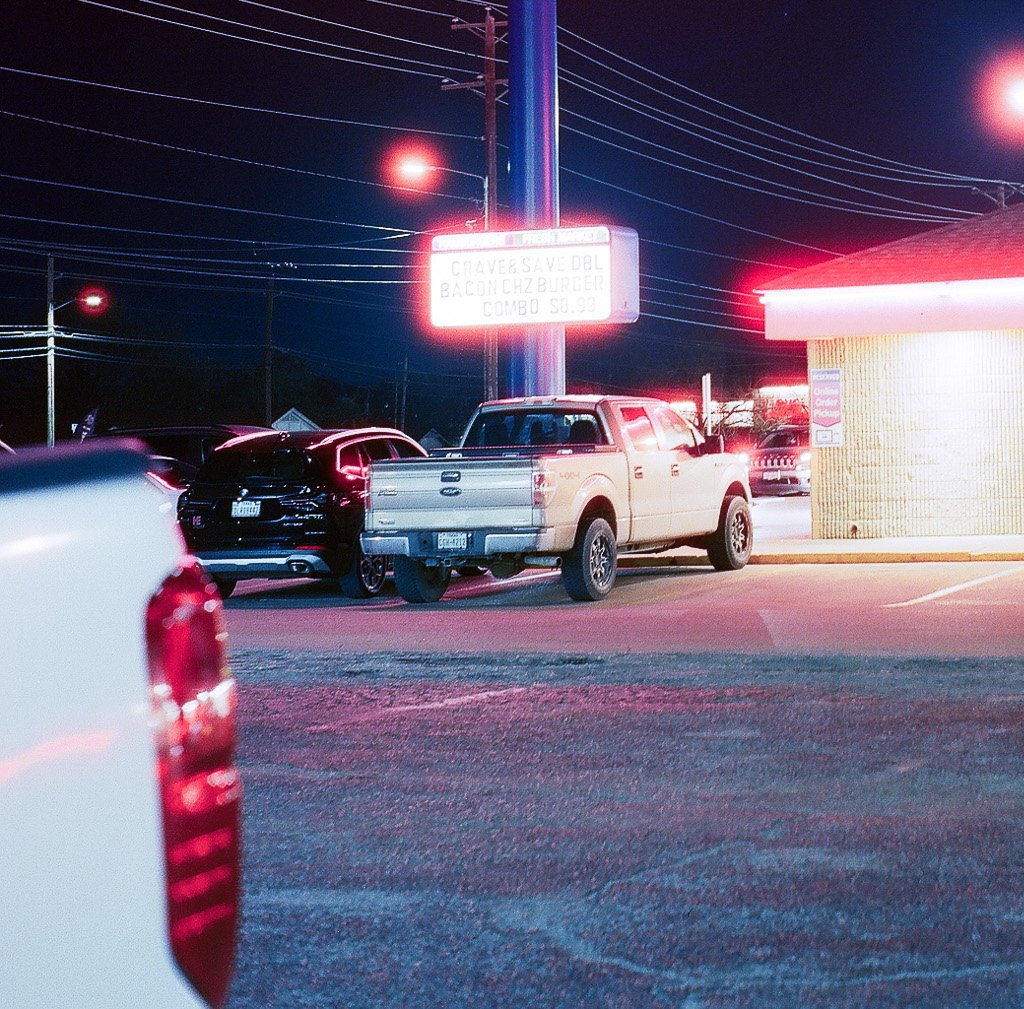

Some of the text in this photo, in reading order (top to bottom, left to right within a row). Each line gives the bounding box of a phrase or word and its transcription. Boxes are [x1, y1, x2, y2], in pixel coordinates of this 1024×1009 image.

[571, 254, 604, 271] DBL
[440, 274, 604, 298] BACON CHZ BURGER
[482, 298, 539, 317] COMBO
